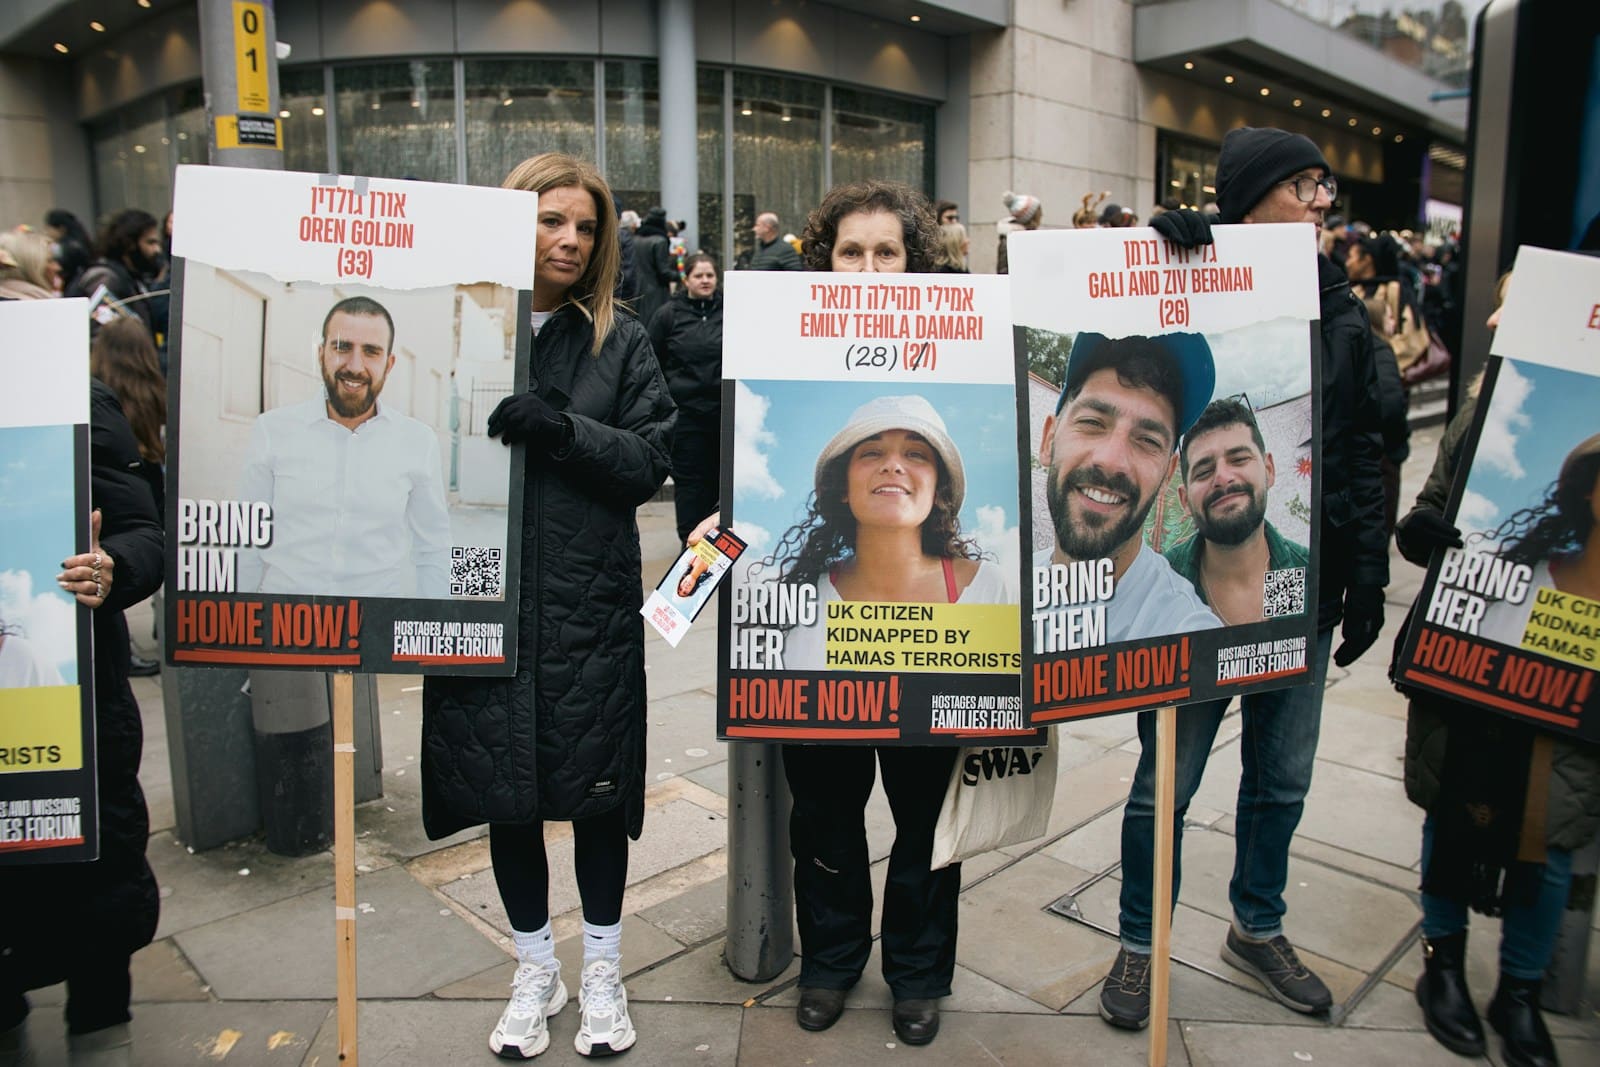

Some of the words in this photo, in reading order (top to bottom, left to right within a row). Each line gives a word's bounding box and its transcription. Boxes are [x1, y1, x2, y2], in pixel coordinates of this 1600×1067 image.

[370, 191, 406, 219] אורן
[300, 216, 346, 244] OREN
[351, 219, 414, 248] GOLDIN
[337, 247, 373, 279] (33)
[1124, 240, 1160, 269] ברמן
[811, 284, 863, 310] דמארי
[867, 284, 921, 310] תהילה
[1089, 272, 1124, 298] GALI
[1129, 270, 1160, 296] AND
[1163, 269, 1187, 295] ZIV
[1191, 267, 1253, 293] BERMAN
[926, 285, 974, 311] אמילי
[800, 313, 849, 338] EMILY
[853, 314, 911, 339] TEHILA
[915, 315, 983, 340] DAMARI
[1159, 298, 1190, 328] (26)
[845, 344, 898, 371] (28)
[178, 499, 272, 547] BRING
[177, 549, 236, 593] HIM
[1033, 557, 1114, 609] BRING
[1438, 547, 1533, 604] BRING
[731, 582, 817, 626] BRING
[827, 604, 854, 619] UK
[860, 605, 933, 621] CITIZEN
[1425, 584, 1487, 636] HER
[1537, 590, 1567, 609] UK
[177, 600, 263, 645] HOME
[272, 600, 362, 649] NOW!
[394, 620, 440, 636] HOSTAGES
[441, 622, 461, 637] AND
[463, 622, 504, 637] MISSING
[827, 627, 938, 644] KIDNAPPED
[944, 629, 971, 644] BY
[1032, 605, 1107, 655] THEM
[393, 636, 453, 656] FAMILIES
[456, 637, 503, 657] FORUM
[730, 628, 785, 670] HER
[826, 650, 895, 666] HAMAS
[901, 651, 1021, 667] TERRORISTS
[1217, 643, 1256, 662] HOSTAGES
[1257, 641, 1272, 656] AND
[1273, 636, 1306, 653] MISSING
[1522, 630, 1597, 661] HAMAS
[1033, 654, 1108, 704] HOME
[1116, 636, 1192, 692] NOW!
[1217, 656, 1265, 681] FAMILIES
[1267, 649, 1306, 673] FORUM
[1413, 628, 1499, 686] HOME
[1498, 654, 1595, 714] NOW!
[729, 678, 809, 720] HOME
[817, 675, 901, 723] NOW!
[931, 694, 977, 710] HOSTAGES
[977, 695, 996, 710] AND
[997, 696, 1020, 710] MISS
[931, 710, 988, 729] FAMILIES
[990, 710, 1023, 730] FORU
[32, 797, 80, 816] MISSING
[25, 814, 81, 841] FORUM
